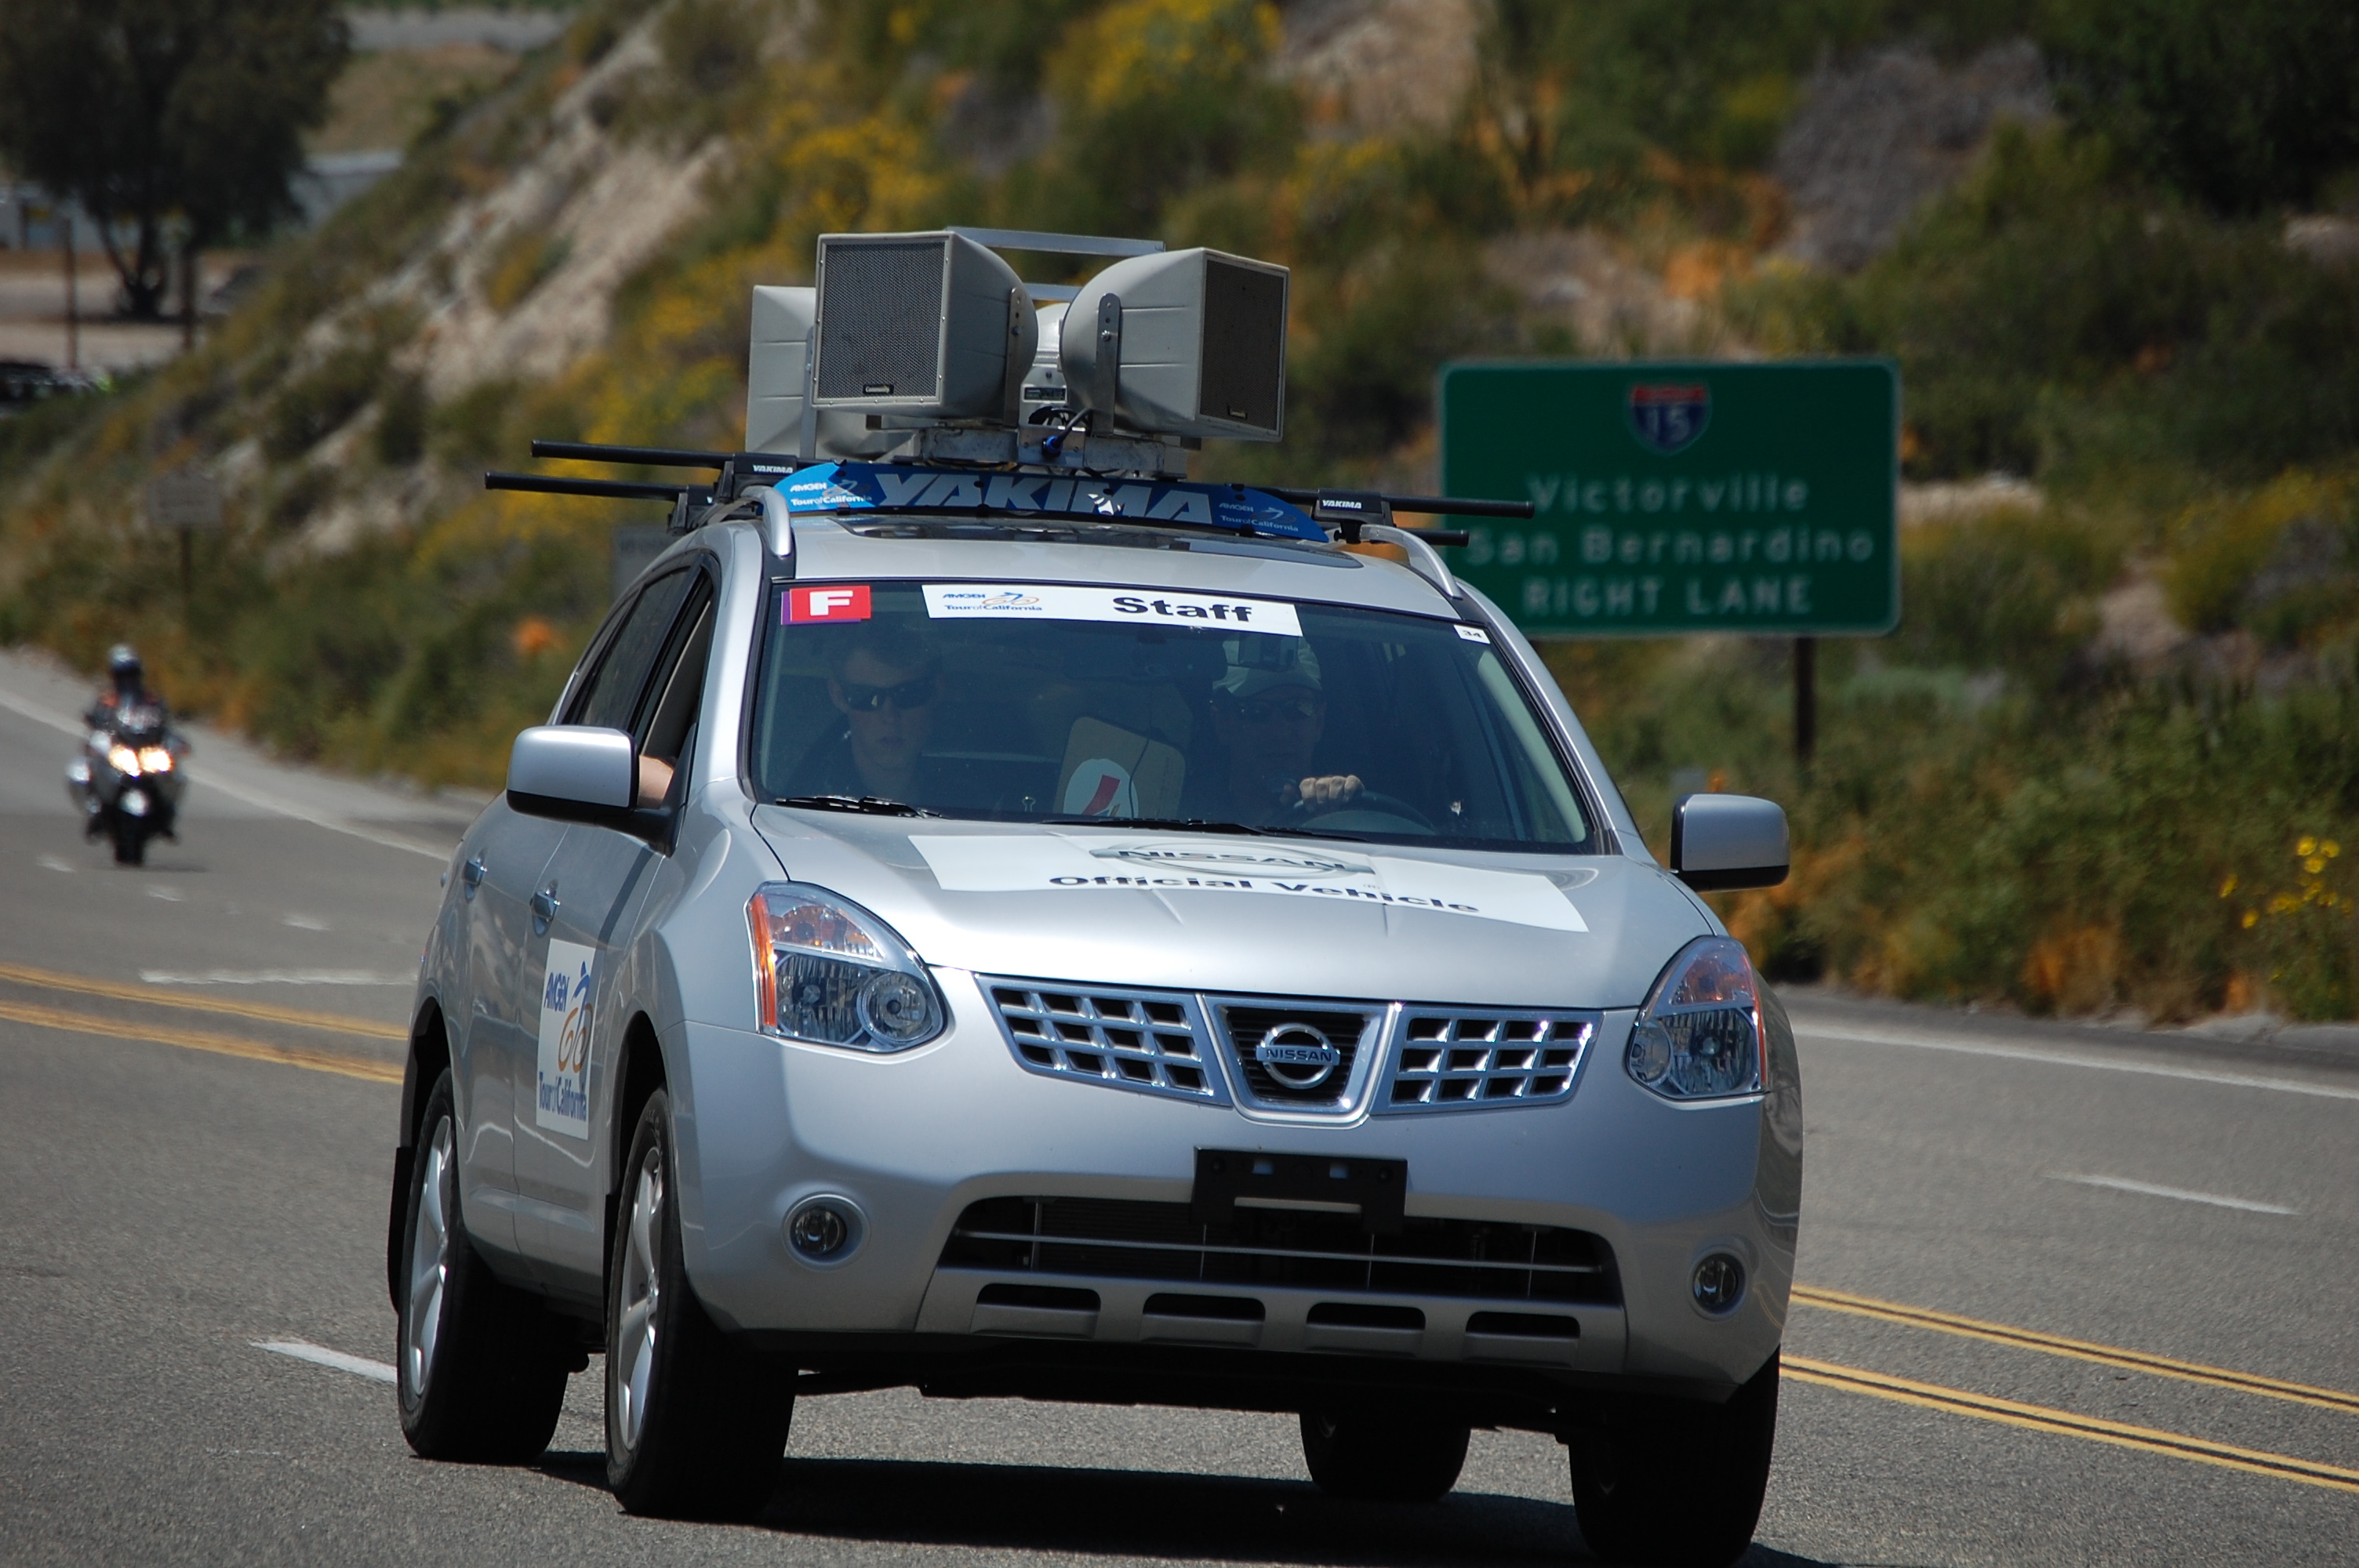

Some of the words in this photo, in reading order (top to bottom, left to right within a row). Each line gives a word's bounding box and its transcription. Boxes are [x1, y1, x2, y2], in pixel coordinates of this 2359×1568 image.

[1646, 405, 1691, 444] 15
[753, 464, 794, 474] YAKIMA
[790, 482, 827, 492] AMGEN
[874, 473, 1213, 525] YAKIMA
[1526, 474, 1810, 513] Victorville
[1219, 503, 1254, 513] AMGEN
[1322, 499, 1362, 510] YAKIMA
[1465, 524, 1561, 567] San
[1579, 524, 1875, 566] Bernardino
[809, 590, 853, 616] F
[1524, 576, 1664, 616] RIGHT
[1686, 576, 1812, 616] LANE
[1113, 597, 1252, 622] Staff
[1118, 850, 1346, 869] NISSAN
[1049, 876, 1253, 889] Official
[1270, 881, 1480, 913] Vehicle
[1266, 1048, 1332, 1062] NISSAN
